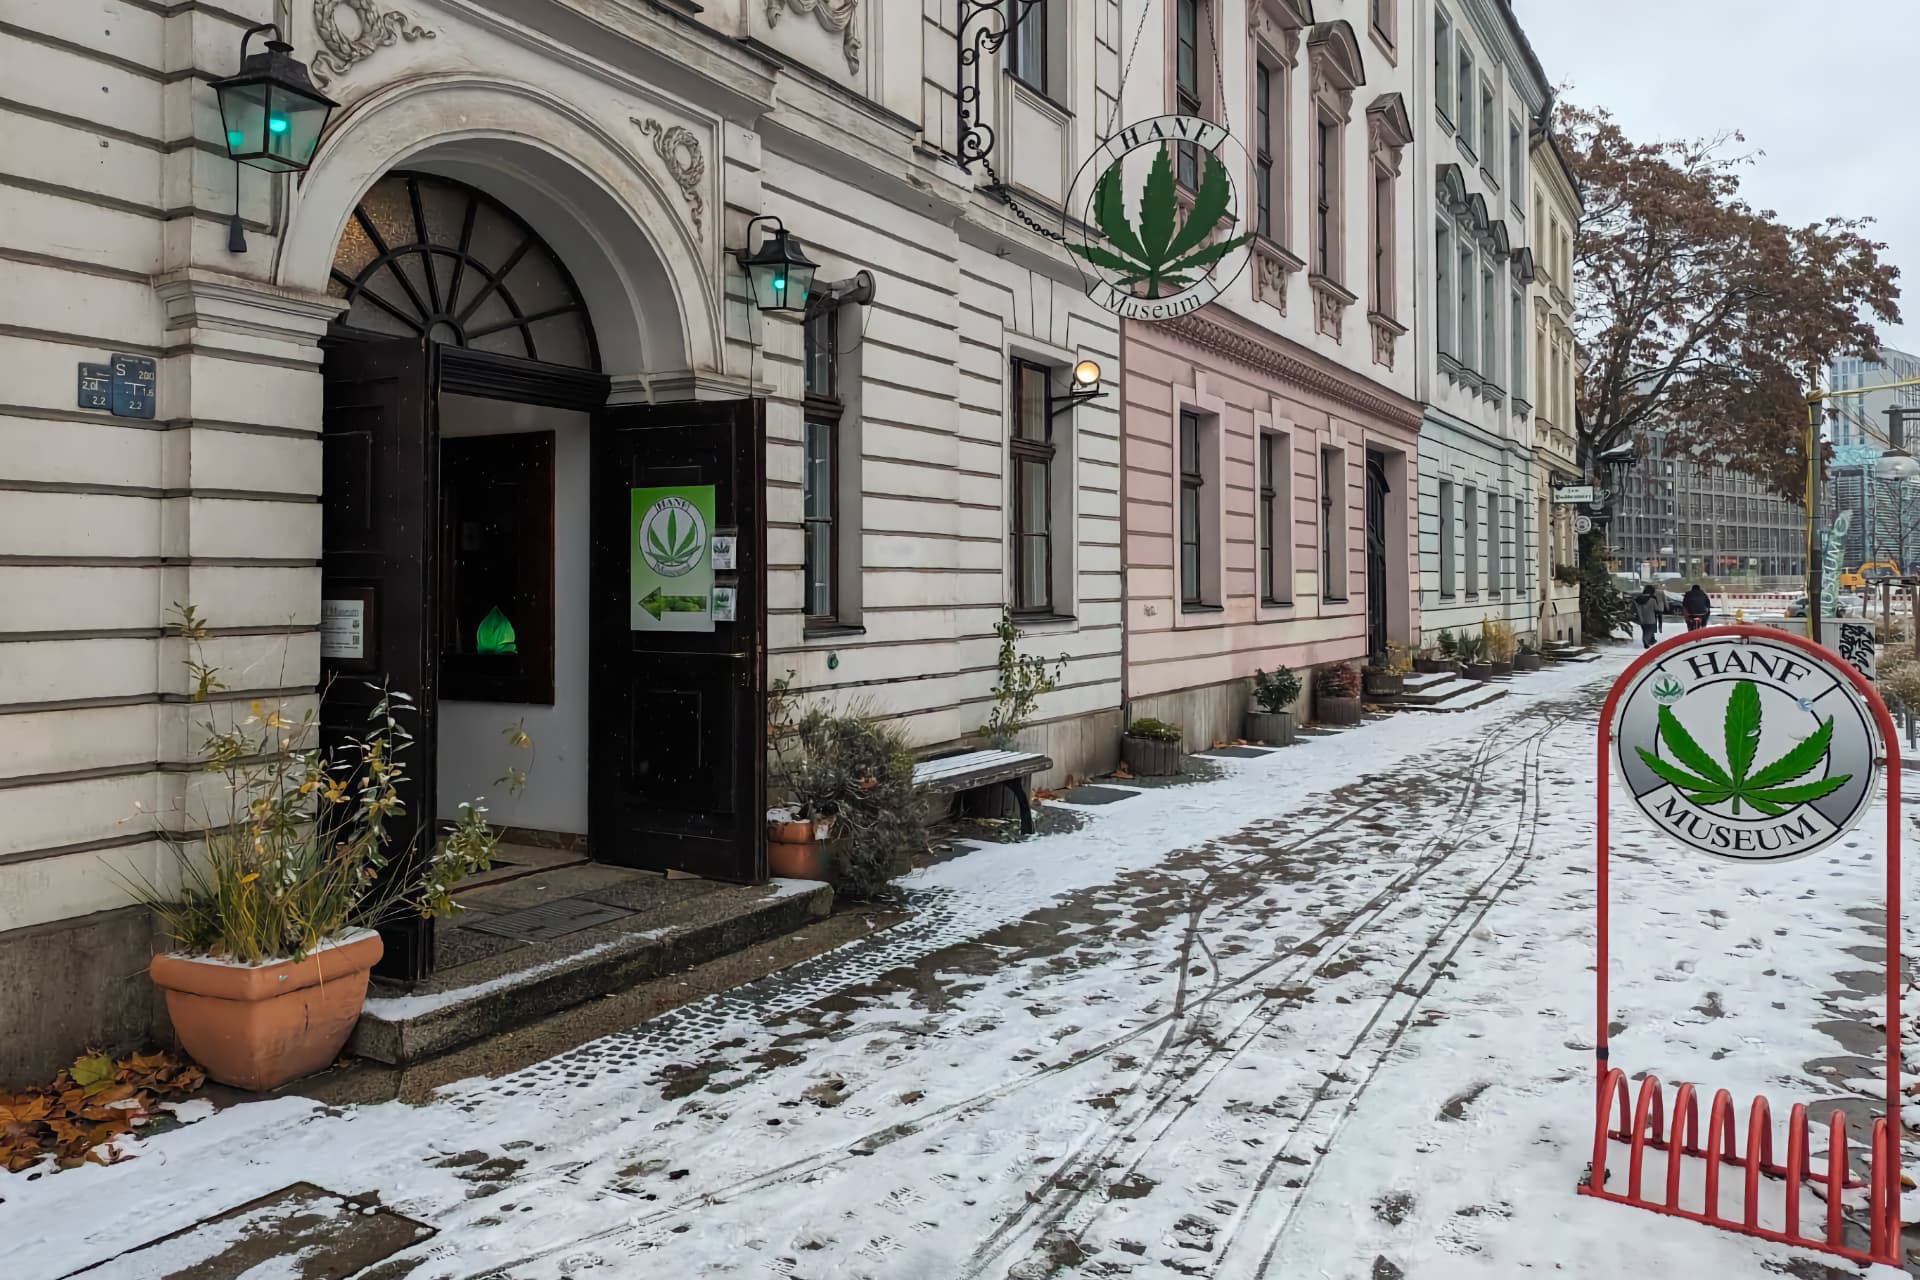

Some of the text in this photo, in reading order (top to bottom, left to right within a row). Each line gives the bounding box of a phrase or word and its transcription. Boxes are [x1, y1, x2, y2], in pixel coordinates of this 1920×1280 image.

[1120, 117, 1214, 150] HANF
[1103, 288, 1202, 319] Museum
[116, 363, 126, 376] S
[1684, 650, 1811, 684] HANF
[1654, 795, 1820, 852] MUSEUM
